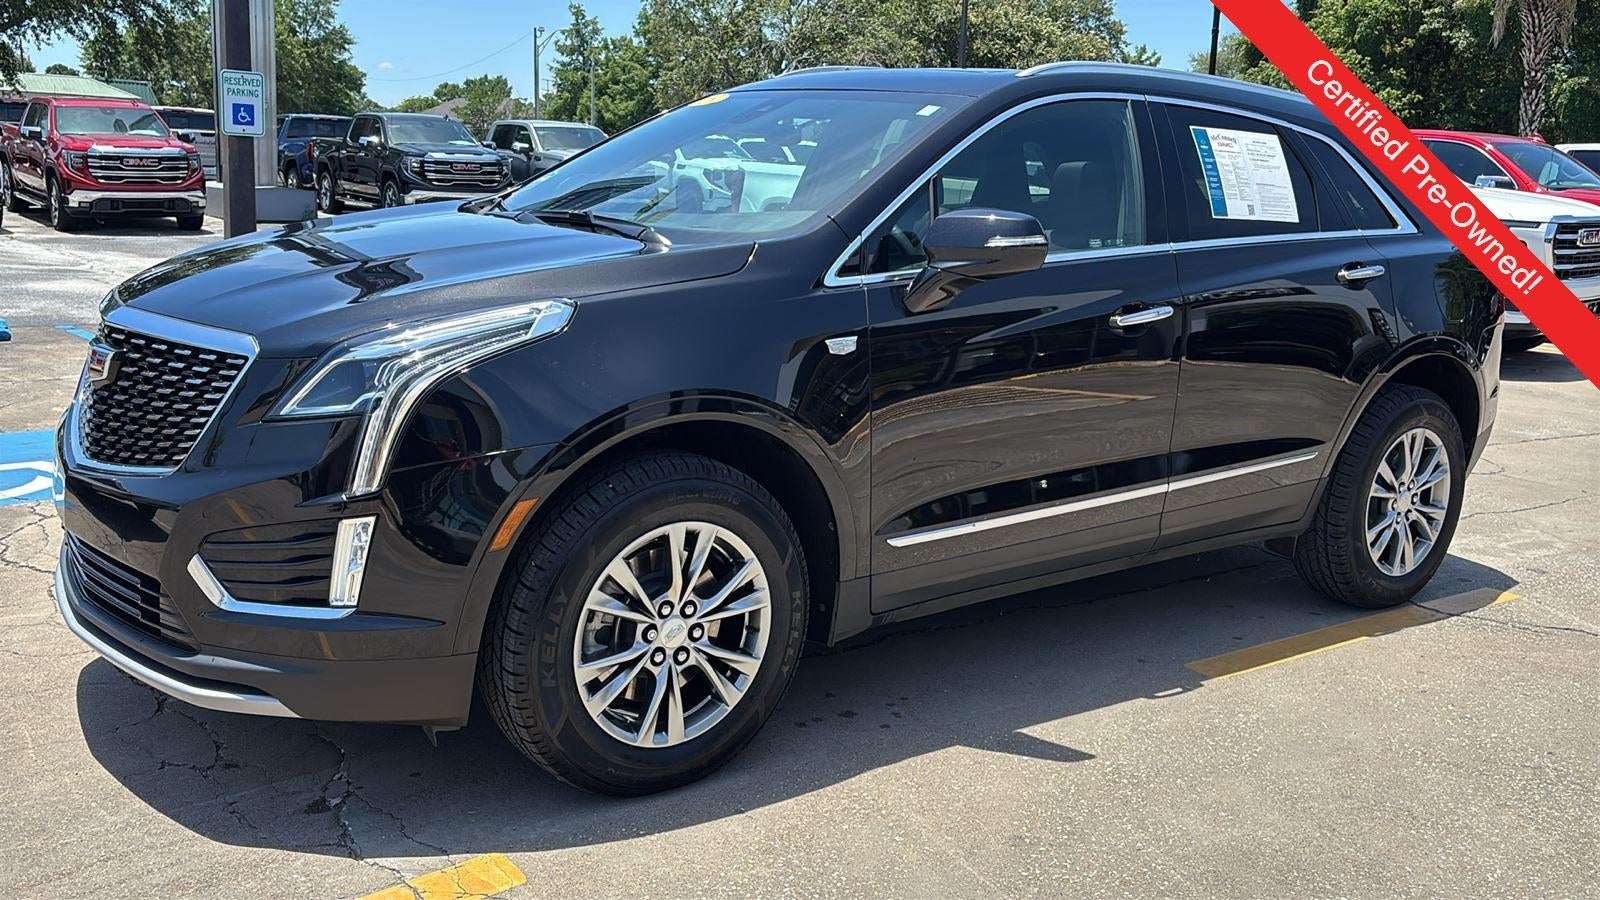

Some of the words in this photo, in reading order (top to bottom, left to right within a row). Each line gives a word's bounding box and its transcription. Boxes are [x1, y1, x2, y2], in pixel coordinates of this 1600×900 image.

[224, 77, 261, 87] RESERVED
[226, 87, 260, 97] PARKING
[123, 158, 159, 166] GMC
[541, 588, 568, 687] KELLY
[780, 591, 801, 678] KELLY
